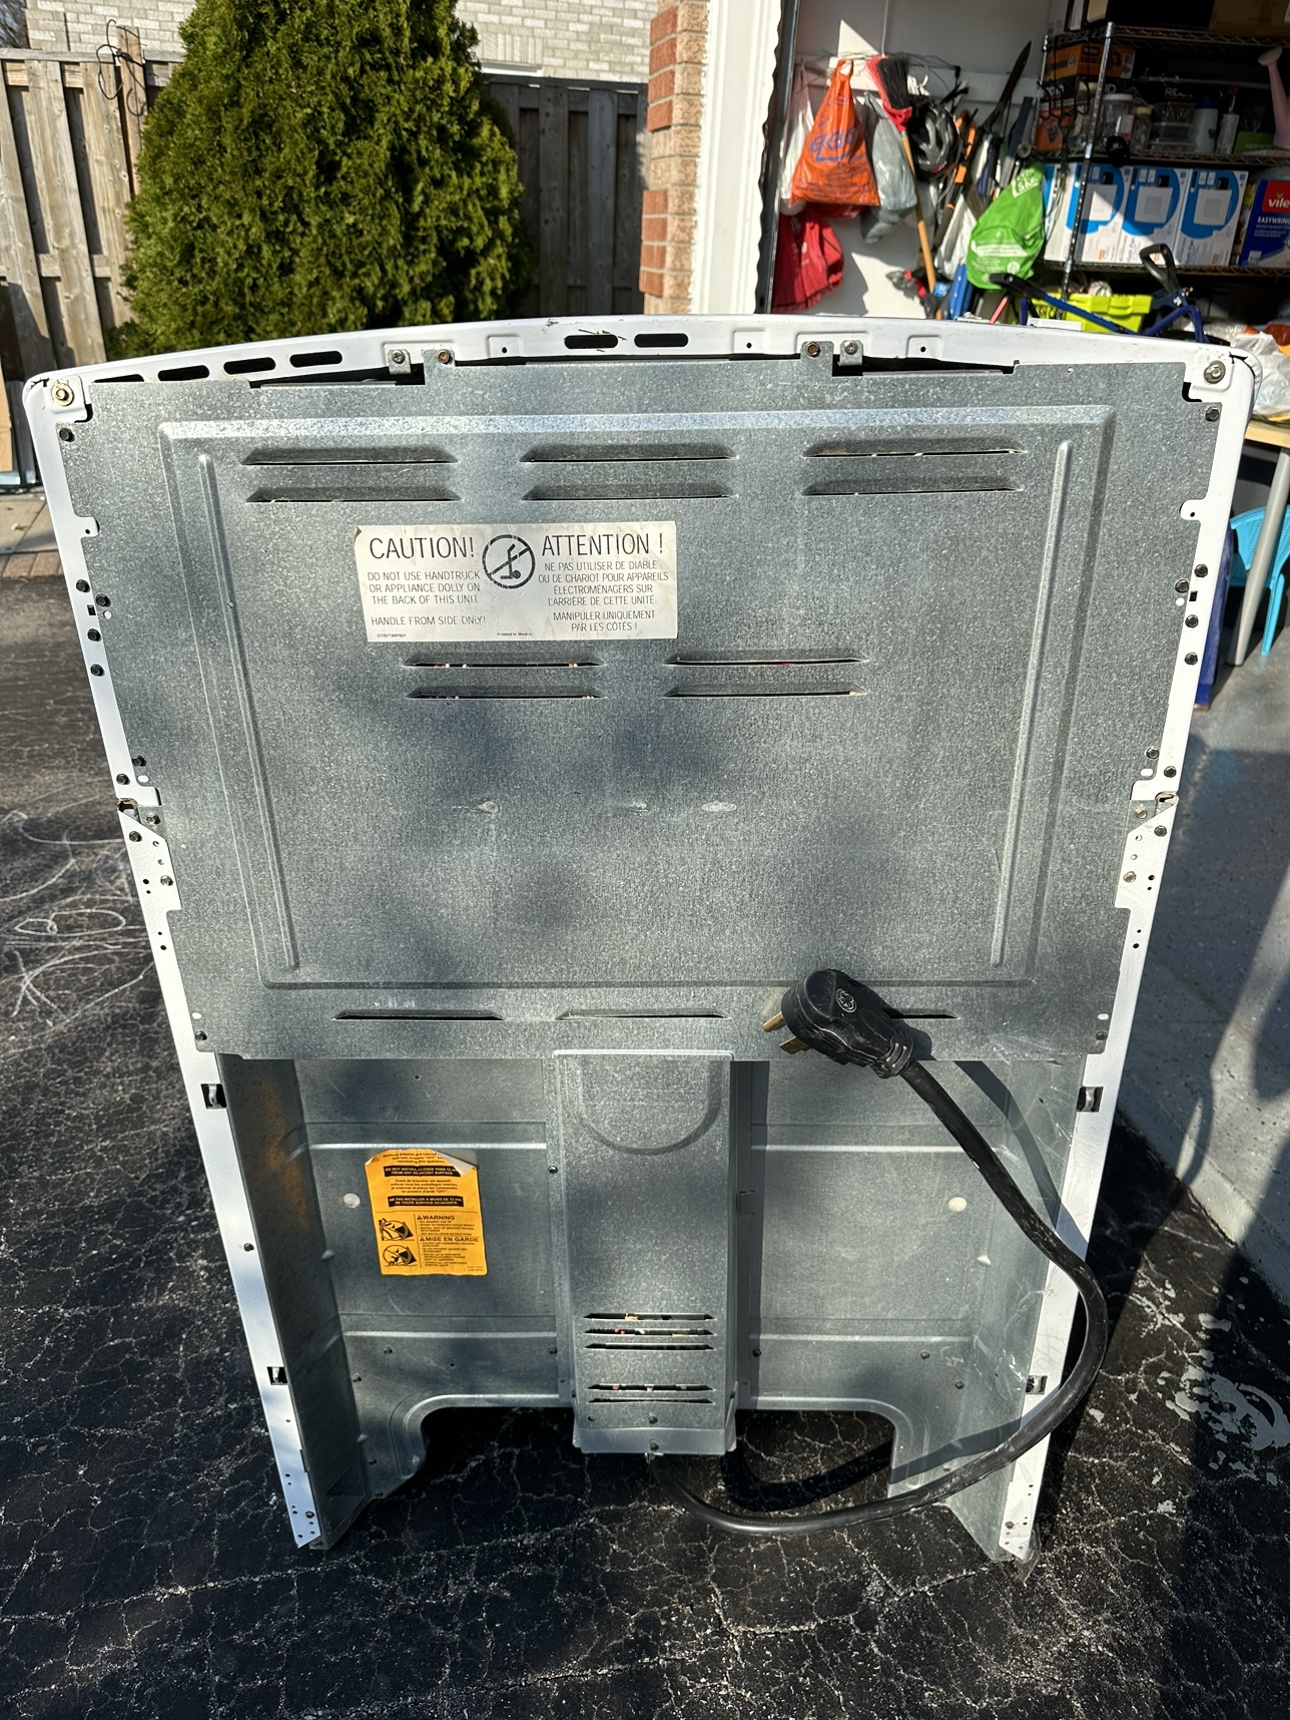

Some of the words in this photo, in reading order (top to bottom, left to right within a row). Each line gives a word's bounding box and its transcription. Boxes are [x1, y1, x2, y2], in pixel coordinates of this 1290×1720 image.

[369, 537, 475, 559] CAUTION!
[541, 533, 649, 556] ATTENTION
[659, 533, 663, 554] !
[544, 562, 555, 571] NE
[558, 562, 574, 571] PAS
[576, 561, 612, 571] UTILISER
[615, 561, 626, 570] DE
[628, 560, 657, 570] DIABLE
[367, 571, 380, 581] DO
[383, 571, 400, 581] NOT
[404, 571, 421, 581] USE
[425, 570, 481, 580] HANDTRUCK
[538, 574, 550, 583] OU
[552, 574, 562, 583] DE
[565, 573, 599, 582] CHARIOT
[602, 572, 624, 582] POUR
[626, 572, 669, 581] APPAREILS
[369, 583, 382, 593] OR
[384, 583, 435, 593] APPLIANCE
[438, 583, 464, 592] DOLLY
[467, 582, 480, 592] ON
[636, 584, 653, 593] SUR
[372, 596, 389, 605] THE
[392, 595, 417, 605] BACK
[418, 595, 431, 605] OF
[434, 595, 454, 604] THIS
[590, 596, 600, 605] DE
[603, 596, 628, 605] CETTE
[371, 616, 406, 626] HANDLE
[409, 616, 436, 625] FROM
[438, 616, 458, 625] SIDE
[461, 615, 486, 625] ONLY!
[553, 611, 601, 621] MANIPULER
[603, 609, 655, 620] UNIQUEMENT
[571, 622, 587, 631] PAR
[589, 622, 604, 631] LES
